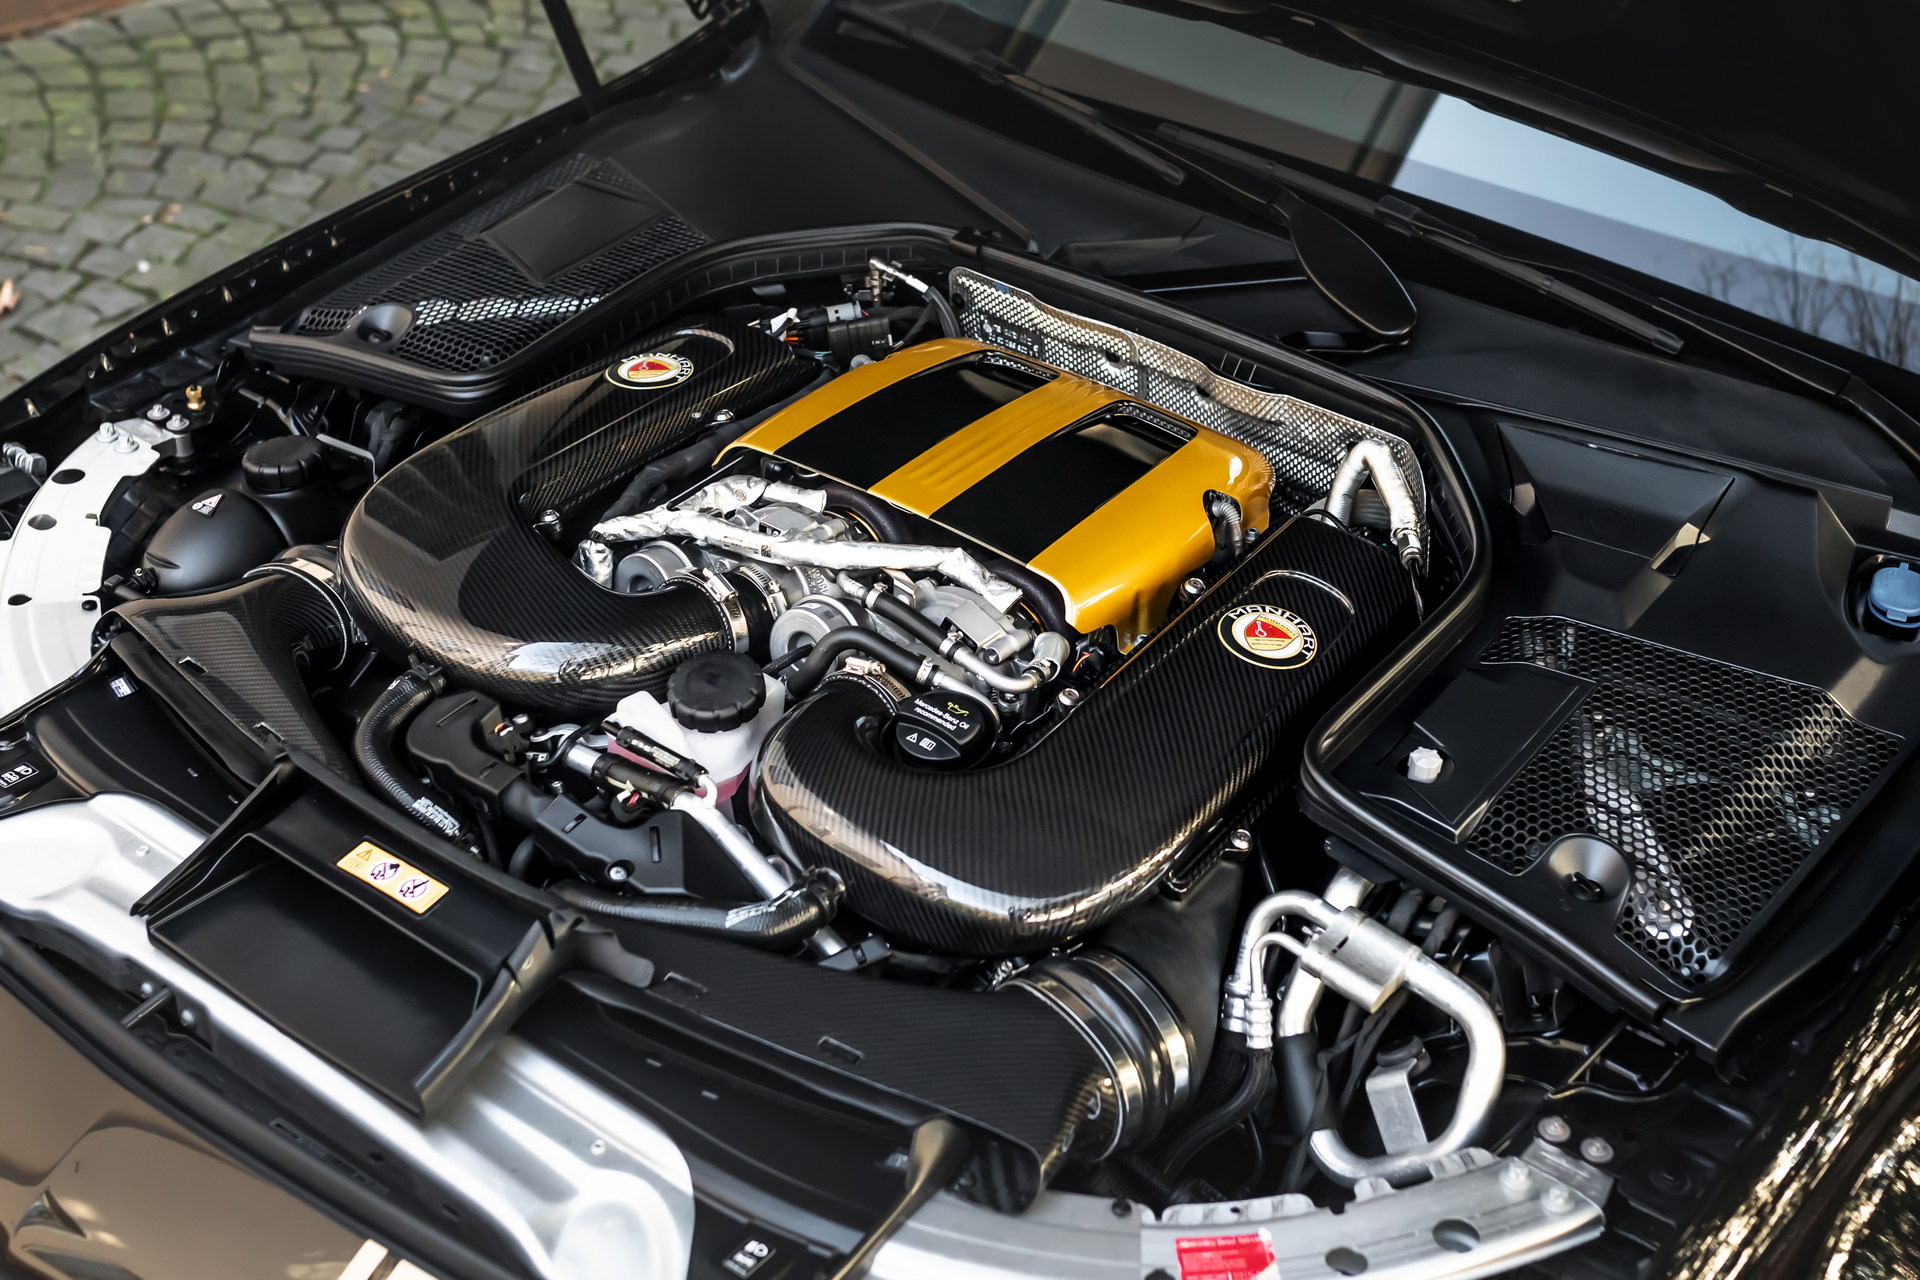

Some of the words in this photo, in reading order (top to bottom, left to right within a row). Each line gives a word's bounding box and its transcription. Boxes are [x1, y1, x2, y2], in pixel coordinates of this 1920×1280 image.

[621, 352, 691, 381] MANHART
[1227, 605, 1315, 660] MANHART
[914, 698, 960, 725] Mercedes-Benz
[959, 721, 970, 730] Oil
[914, 706, 957, 731] recommended
